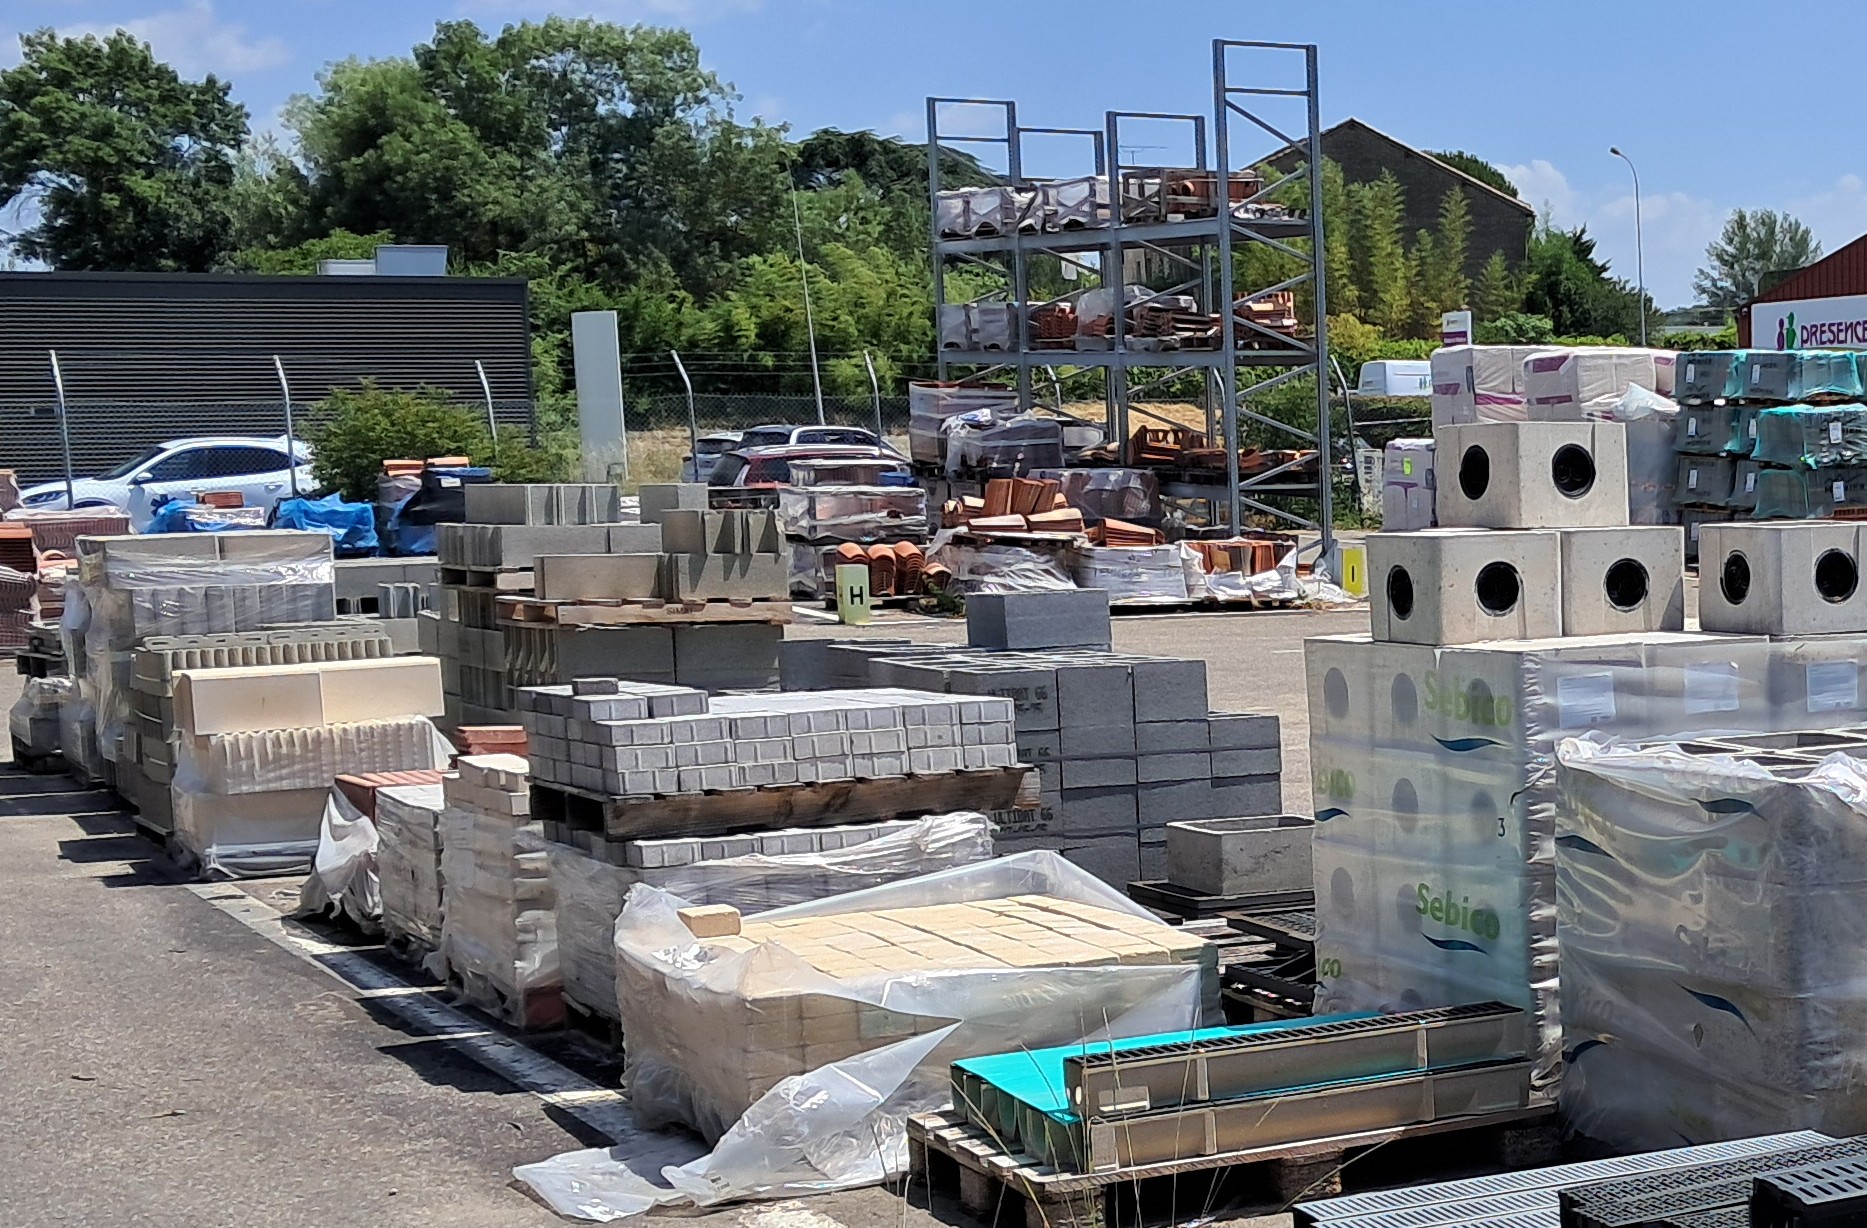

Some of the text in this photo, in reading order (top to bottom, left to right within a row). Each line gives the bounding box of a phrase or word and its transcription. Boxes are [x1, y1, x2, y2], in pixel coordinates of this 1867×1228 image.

[850, 586, 863, 605] H
[1497, 817, 1506, 837] 3
[1416, 882, 1500, 940] Sebico
